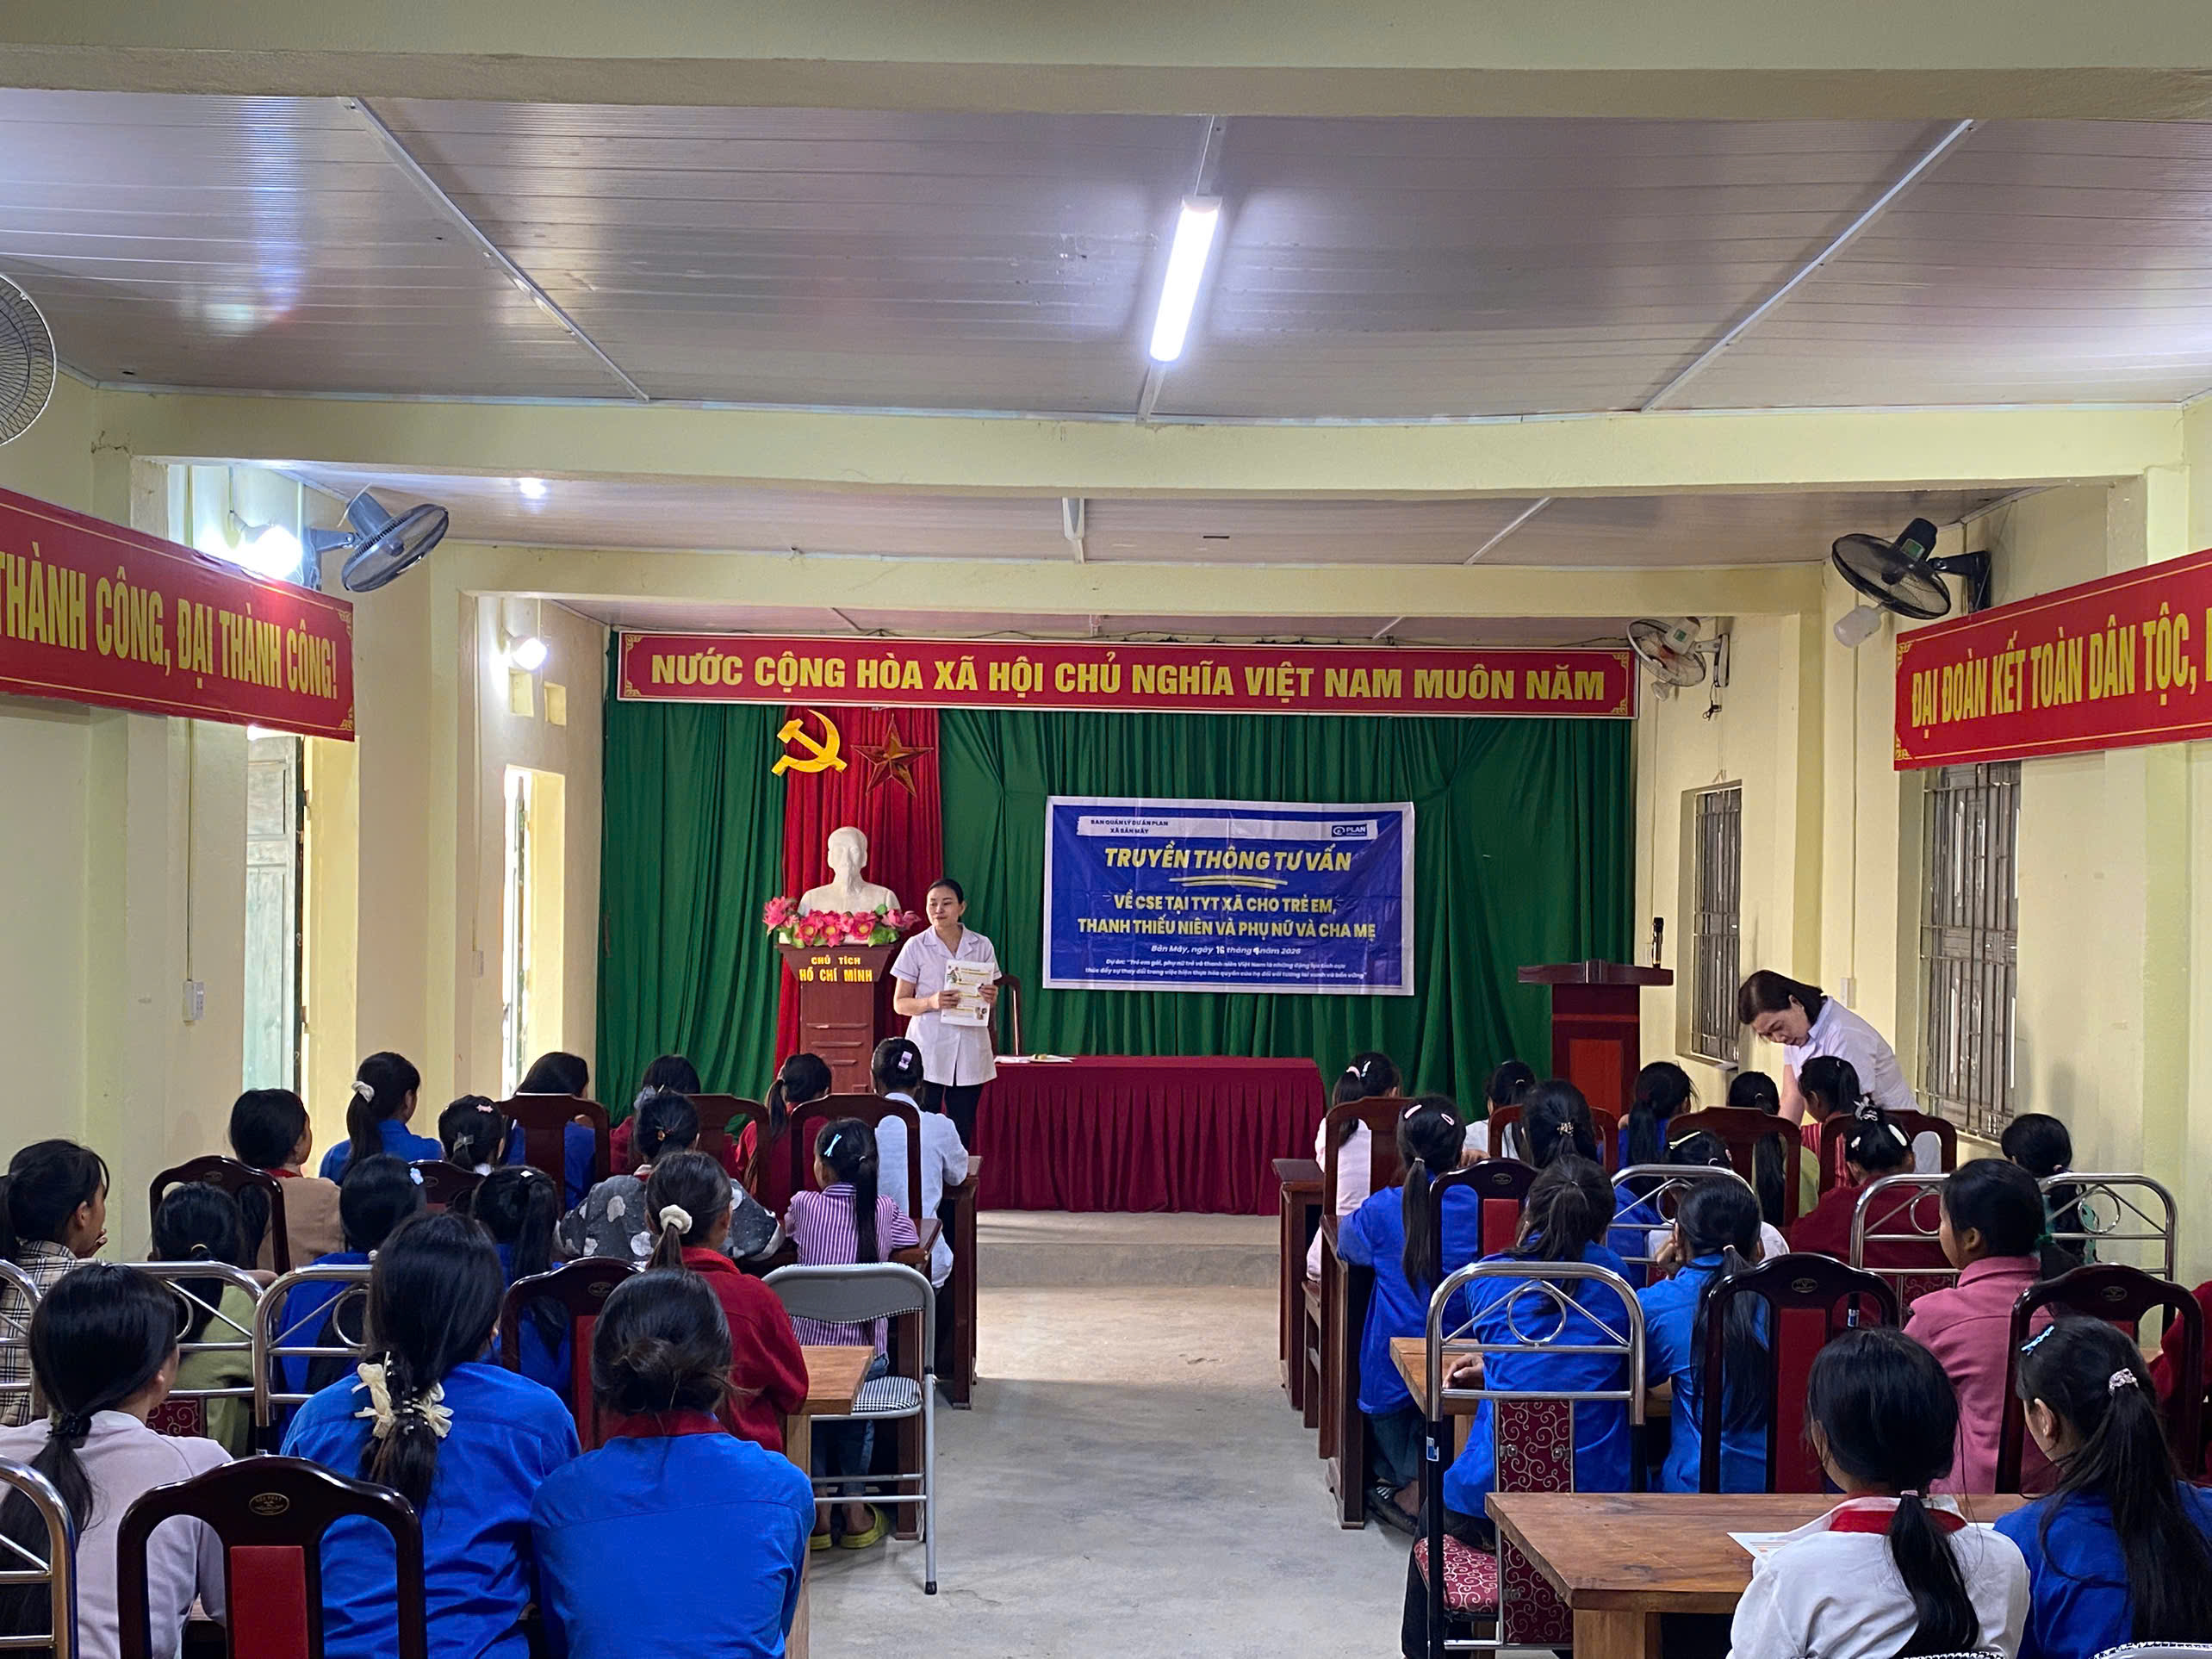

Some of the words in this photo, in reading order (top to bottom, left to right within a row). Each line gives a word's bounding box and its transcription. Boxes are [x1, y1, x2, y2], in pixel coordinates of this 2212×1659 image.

[95, 565, 171, 676] CÔNG,
[177, 599, 214, 689] ĐẠI
[219, 602, 283, 688] THÀNH
[286, 618, 339, 699] CÔNG!
[651, 647, 743, 687] NƯỚC
[755, 650, 846, 693] CỘNG
[857, 653, 923, 690] HÒA
[934, 656, 979, 691] XÃ
[989, 656, 1044, 699] HỘI
[1054, 651, 1122, 693] CHỦ
[1132, 660, 1234, 697] NGHĨA
[1245, 662, 1314, 703] VIỆT
[1324, 668, 1401, 699] NAM
[1414, 663, 1515, 700] MUÔN
[1525, 664, 1606, 701] NĂM
[1911, 668, 1938, 739] ĐẠI
[1942, 648, 1988, 724] ĐOÀN
[1991, 631, 2026, 715] KẾT
[2030, 626, 2083, 709] TOÀN
[2089, 614, 2136, 700] DÂN
[2143, 602, 2196, 706] TỘC,
[1105, 840, 1190, 868] TRUYỀN
[1194, 845, 1271, 870] THÔNG
[1274, 850, 1304, 871] TƯ
[1305, 843, 1351, 872] VẤN
[1114, 889, 1133, 910] VỀ
[1135, 896, 1163, 910] CSE
[1165, 896, 1189, 915] TẠI
[1191, 897, 1220, 910] TYT
[1221, 894, 1244, 911] XÃ
[1246, 898, 1279, 912] CHO
[1282, 894, 1308, 913] TRẺ
[1311, 898, 1336, 916] EM,
[1078, 918, 1130, 933] THANH
[1133, 914, 1175, 935] THIẾU
[1177, 917, 1213, 935] NIÊN
[1215, 917, 1236, 935] VÀ
[1239, 922, 1269, 941] PHỤ
[1271, 919, 1294, 937] NỮ
[1296, 918, 1316, 937] VÀ
[1319, 923, 1351, 938] CHA
[1353, 923, 1376, 942] MẸ
[811, 954, 831, 965] CHỦ
[838, 955, 861, 965] TÍCH
[1190, 946, 1214, 955] ngày
[1215, 945, 1225, 954] 16
[1227, 947, 1252, 955] tháng
[798, 966, 814, 982] HỒ
[819, 966, 838, 982] CHÍ
[843, 967, 873, 982] MINH
